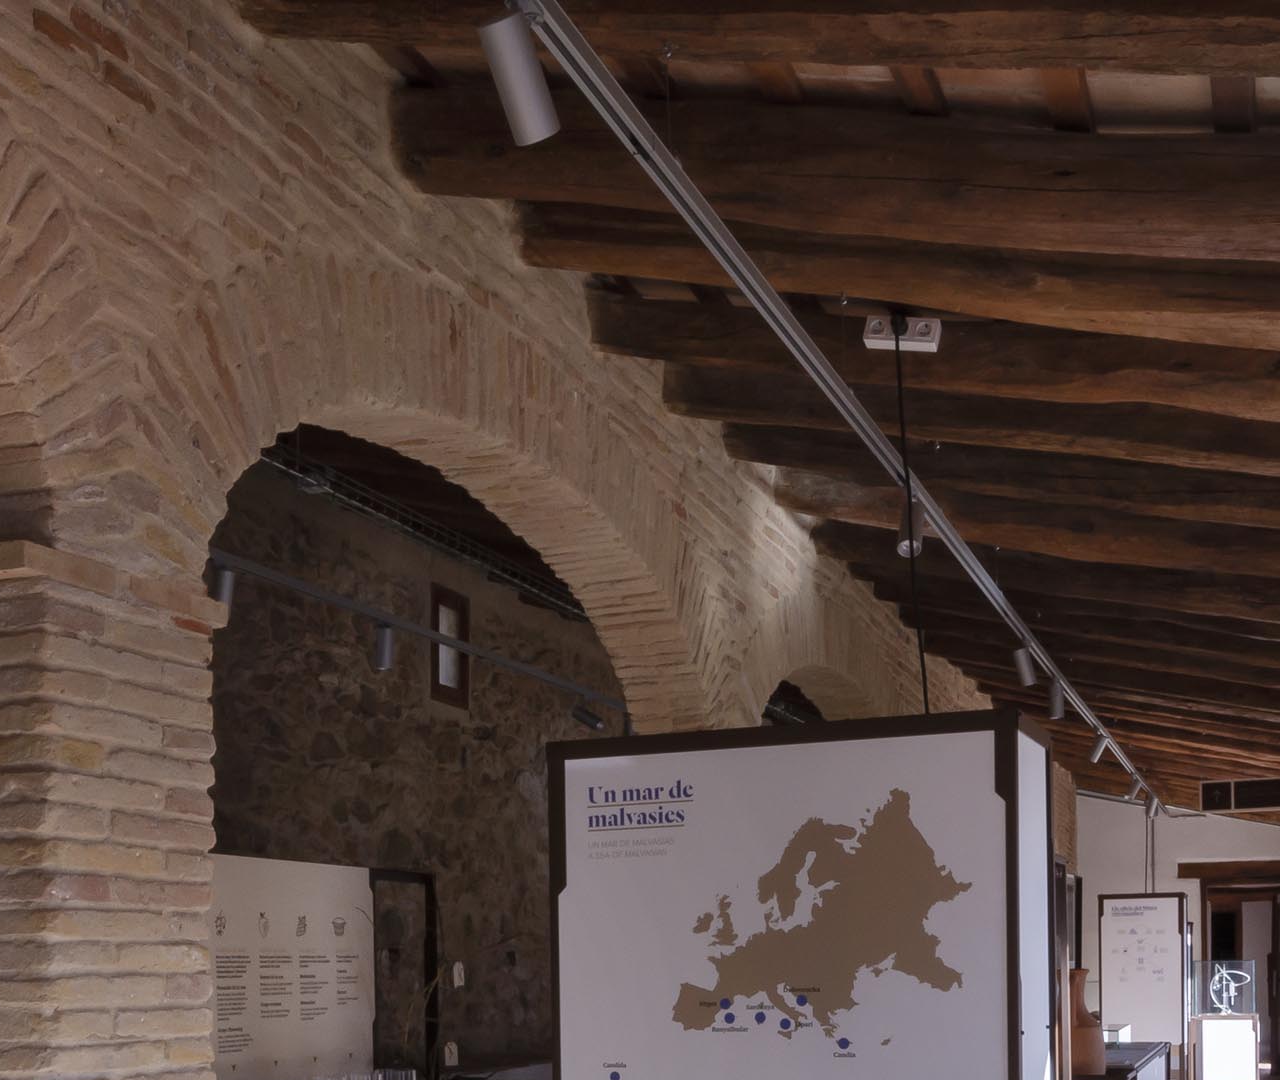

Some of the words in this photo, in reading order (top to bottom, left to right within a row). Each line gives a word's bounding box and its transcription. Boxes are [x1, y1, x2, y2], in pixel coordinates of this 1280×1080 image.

[588, 786, 617, 804] Un
[622, 786, 664, 802] mar
[669, 780, 694, 799] de
[588, 806, 685, 828] malvasies
